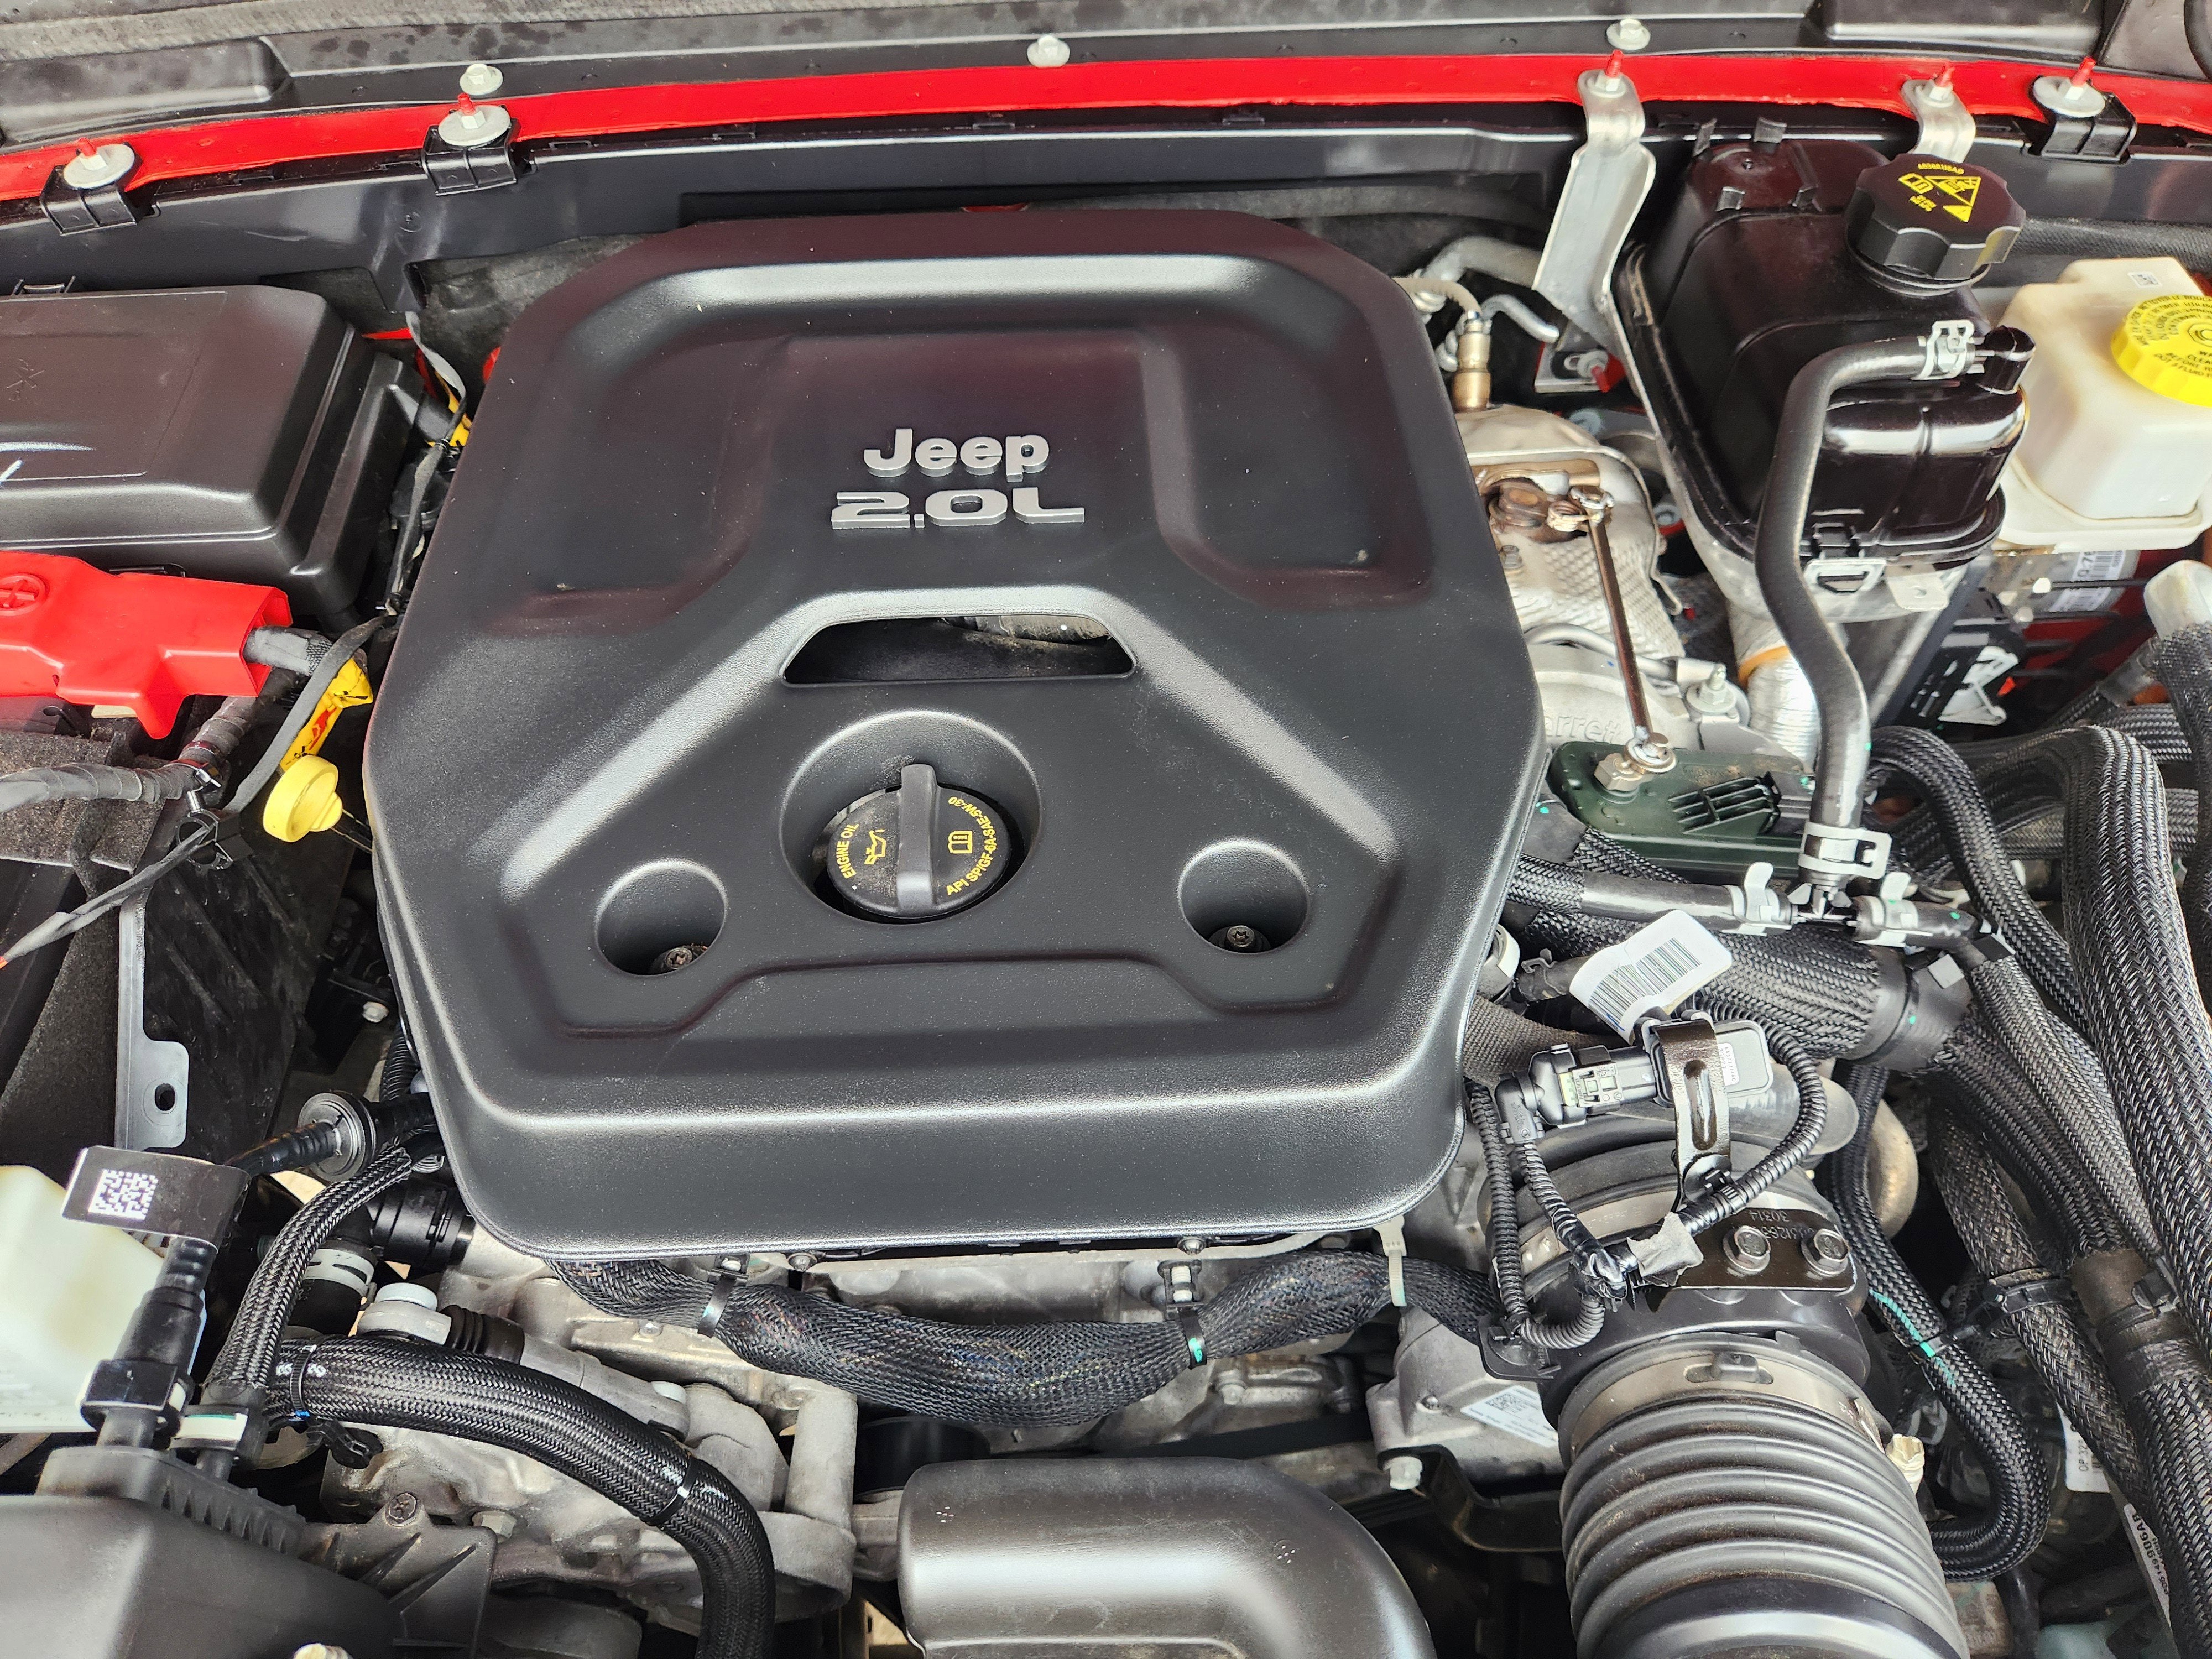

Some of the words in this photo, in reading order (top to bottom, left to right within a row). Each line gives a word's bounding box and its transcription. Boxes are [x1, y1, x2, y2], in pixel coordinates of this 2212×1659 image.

[2188, 354, 2212, 364] CLEA
[863, 428, 1050, 482] Jeep
[831, 487, 1084, 529] 2.0L
[841, 823, 859, 839] OIL
[836, 840, 857, 879] ENGINE
[946, 878, 969, 895] API
[1748, 1209, 1790, 1223] 30314
